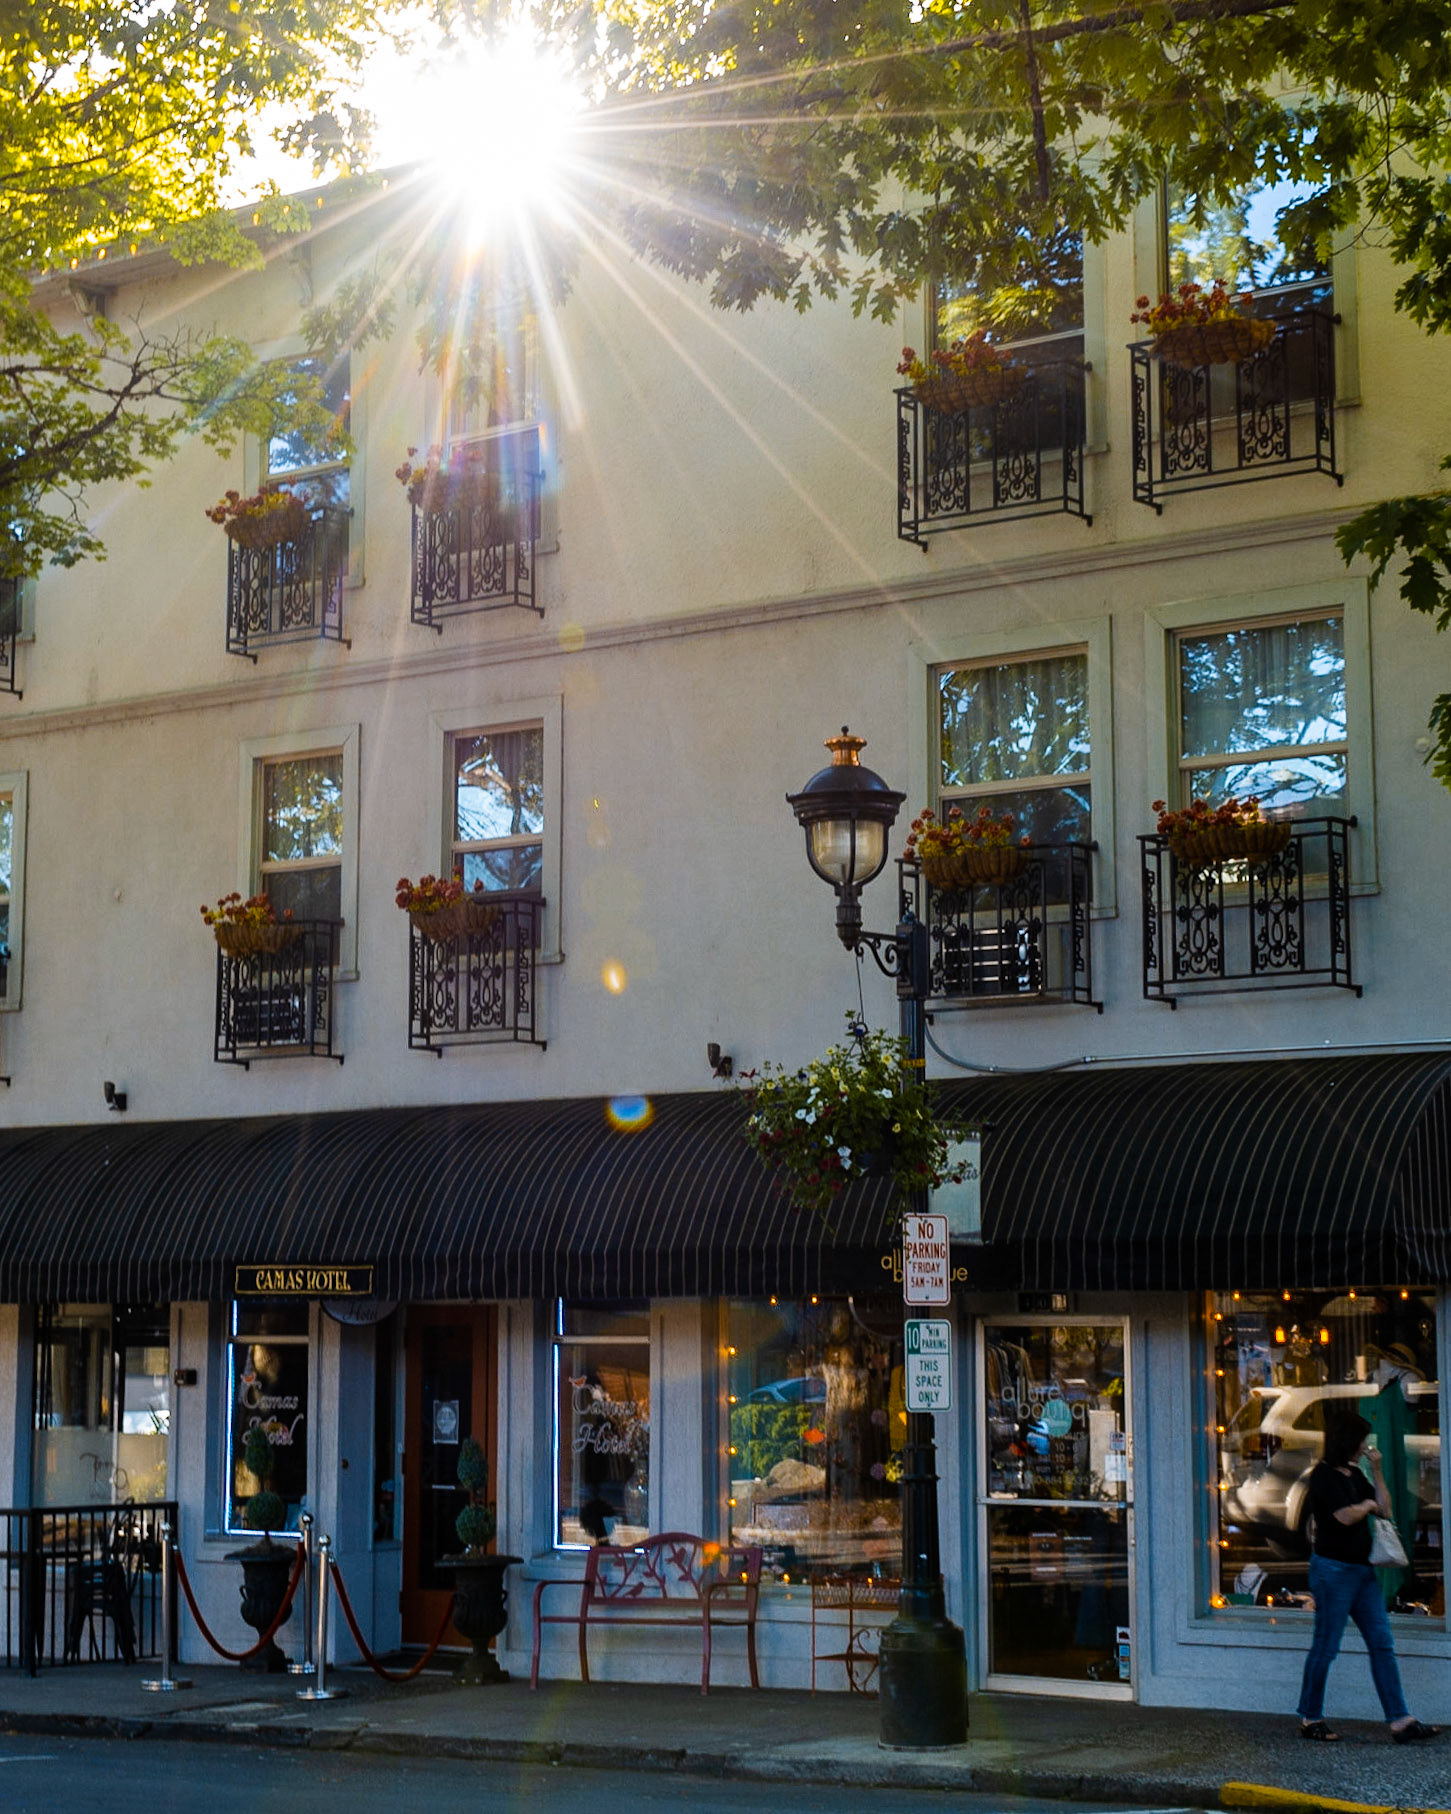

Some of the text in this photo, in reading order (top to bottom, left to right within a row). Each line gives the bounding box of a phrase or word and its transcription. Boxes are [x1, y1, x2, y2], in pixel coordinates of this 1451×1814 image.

[917, 1222, 935, 1240] NO
[907, 1242, 946, 1259] PARKING
[912, 1261, 941, 1274] FRIDAY
[255, 1269, 351, 1291] CAMAS HOTEL
[907, 1327, 940, 1350] 10 MIN
[922, 1339, 947, 1349] PARKING
[919, 1360, 939, 1372] THIS
[915, 1375, 943, 1388] SPACE
[1002, 1376, 1060, 1402] allure
[242, 1381, 299, 1410] Camas
[573, 1384, 637, 1415] Camas
[918, 1391, 940, 1403] ONLY
[571, 1420, 643, 1454] Hotel
